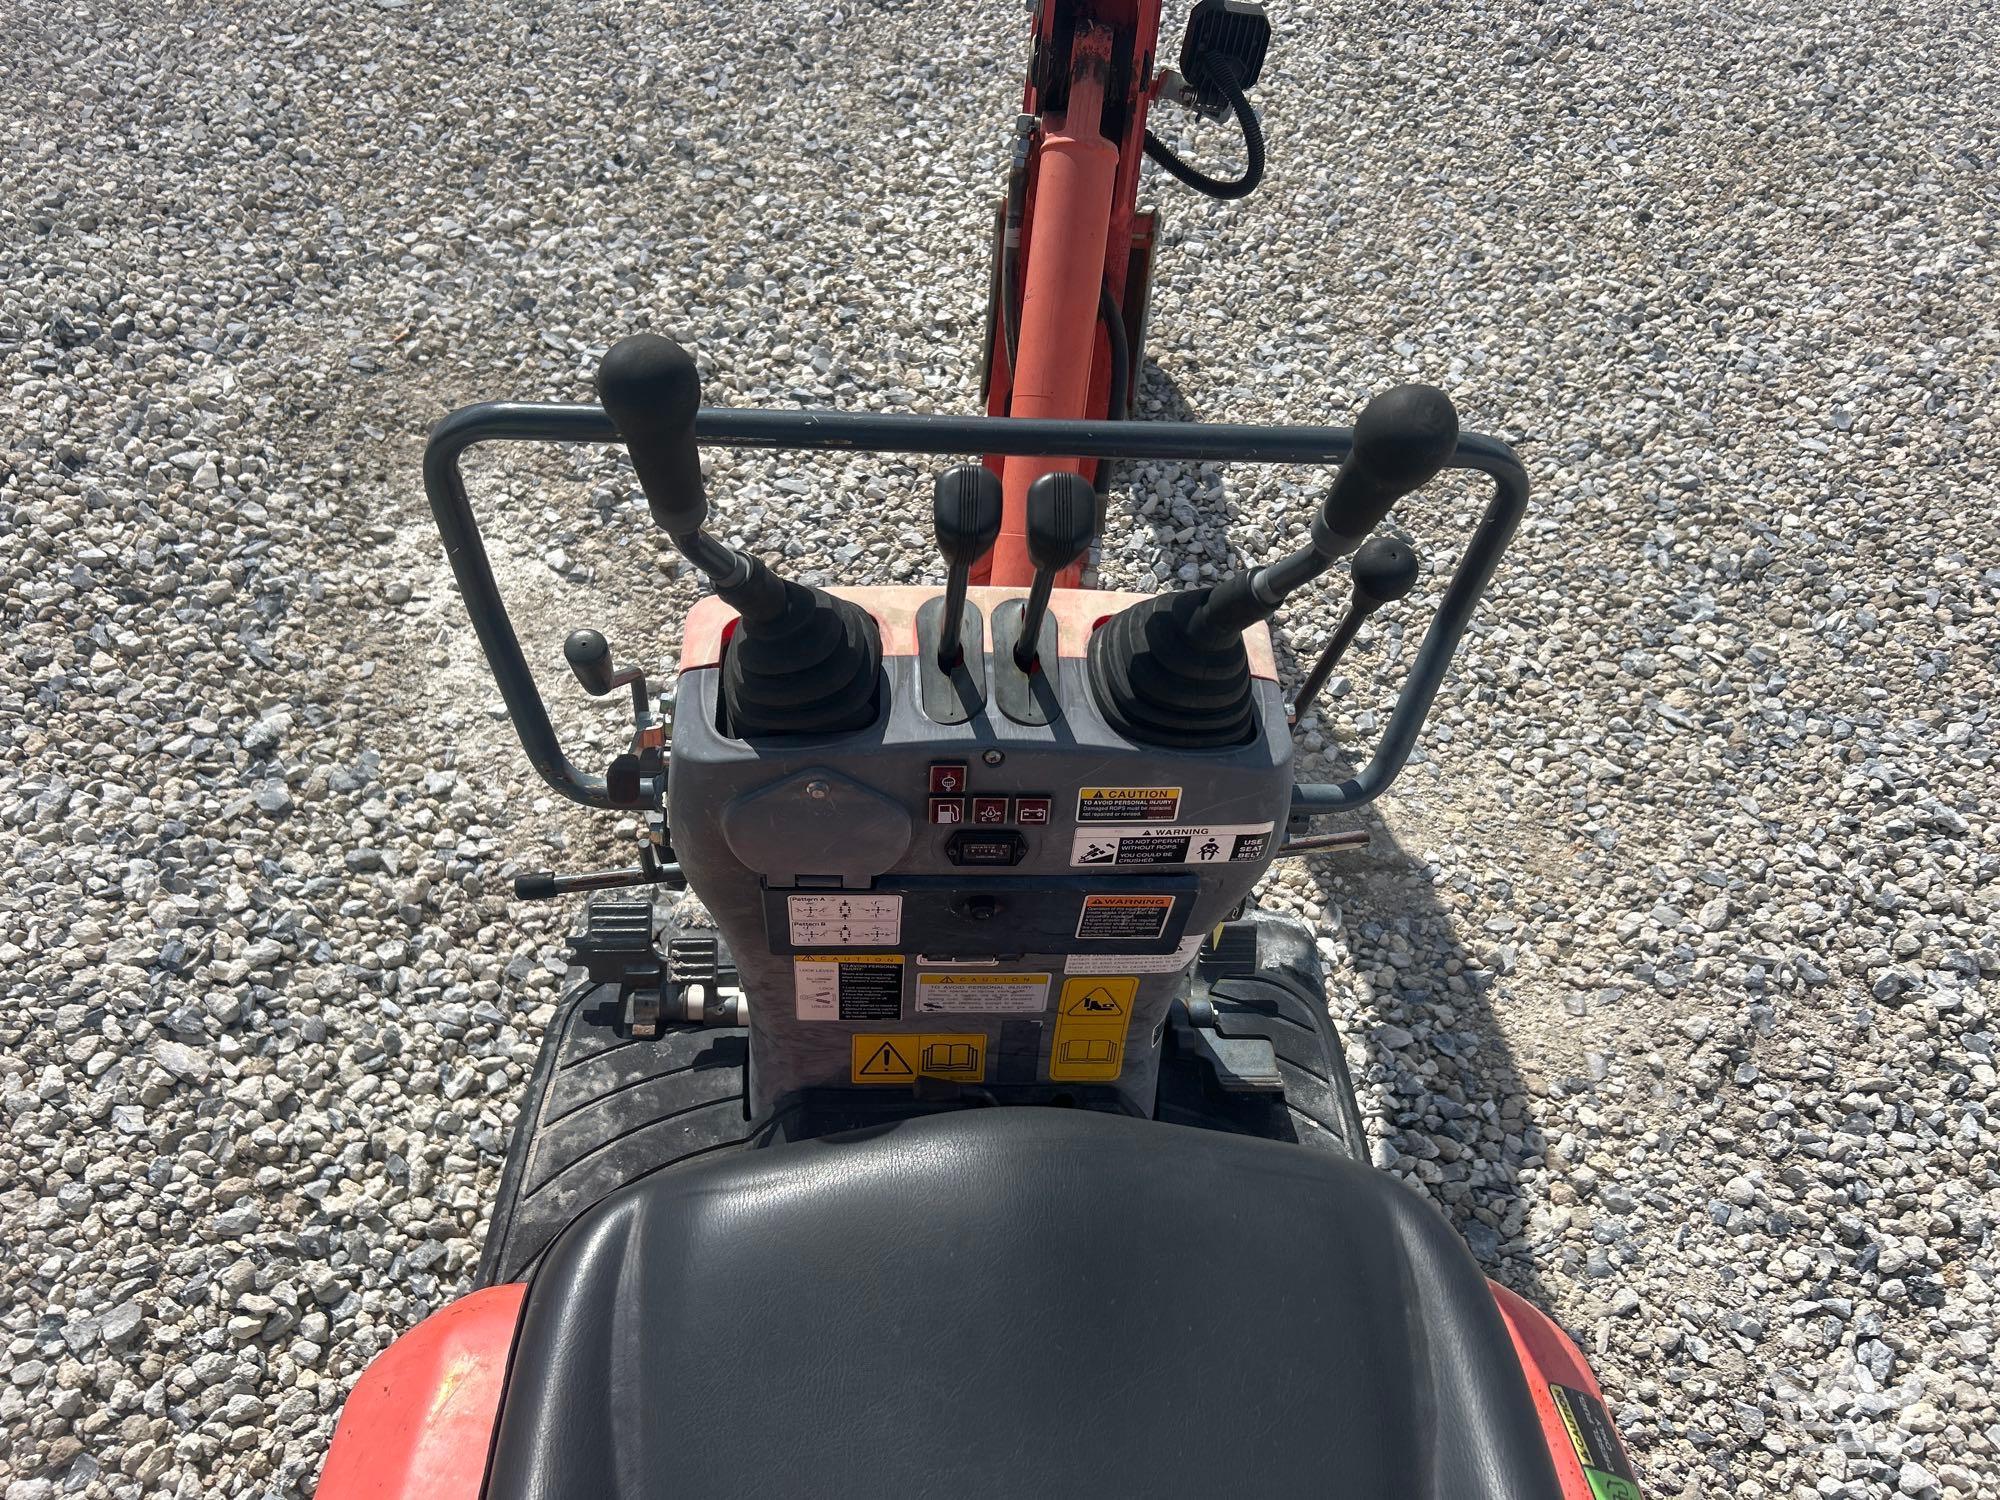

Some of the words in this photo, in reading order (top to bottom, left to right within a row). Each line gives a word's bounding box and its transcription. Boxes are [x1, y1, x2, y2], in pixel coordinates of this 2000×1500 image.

[1108, 790, 1168, 799] CAUTION
[1155, 828, 1209, 836] WARNING
[1244, 838, 1263, 846] USE
[1239, 845, 1264, 853] SEAT
[1554, 1389, 1586, 1450] CAUTION
[1578, 1394, 1597, 1425] FUEL
[1594, 1417, 1613, 1453] ONLY
[1593, 1428, 1615, 1473] DIESEL
